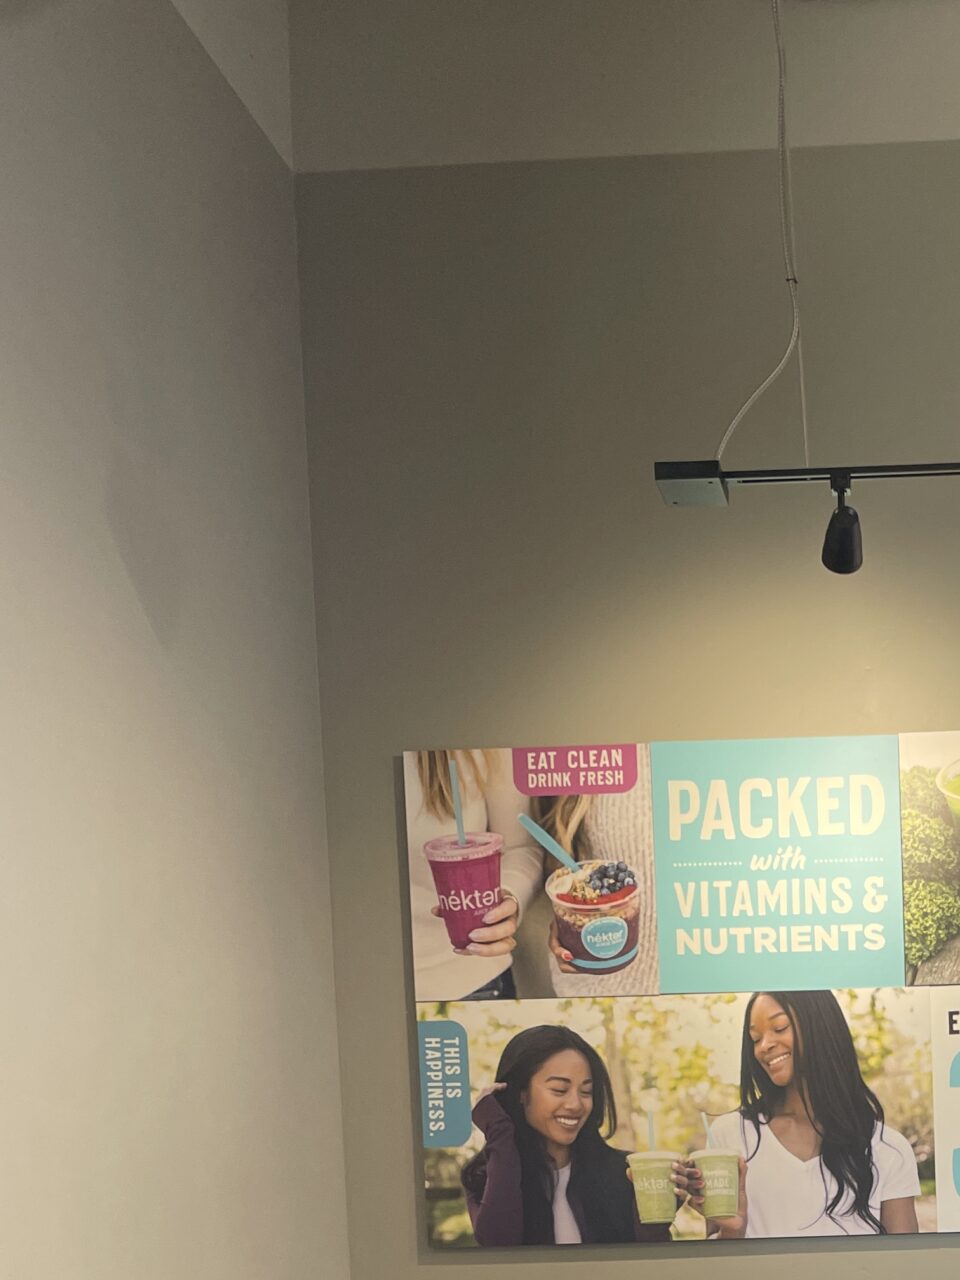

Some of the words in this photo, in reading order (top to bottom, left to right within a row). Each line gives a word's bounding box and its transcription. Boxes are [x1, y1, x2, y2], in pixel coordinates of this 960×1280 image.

[527, 751, 557, 770] EAT
[567, 749, 623, 768] CLEAN
[527, 772, 571, 788] DRINK
[579, 770, 624, 787] FRESH
[667, 774, 886, 841] PACKED
[750, 846, 806, 871] with
[673, 876, 853, 918] VITAMINS
[862, 875, 889, 913] &
[676, 923, 886, 955] NUTRIENTS
[443, 1037, 461, 1075] THIS
[425, 1037, 445, 1137] HAPPINESS.
[446, 1082, 462, 1098] IS
